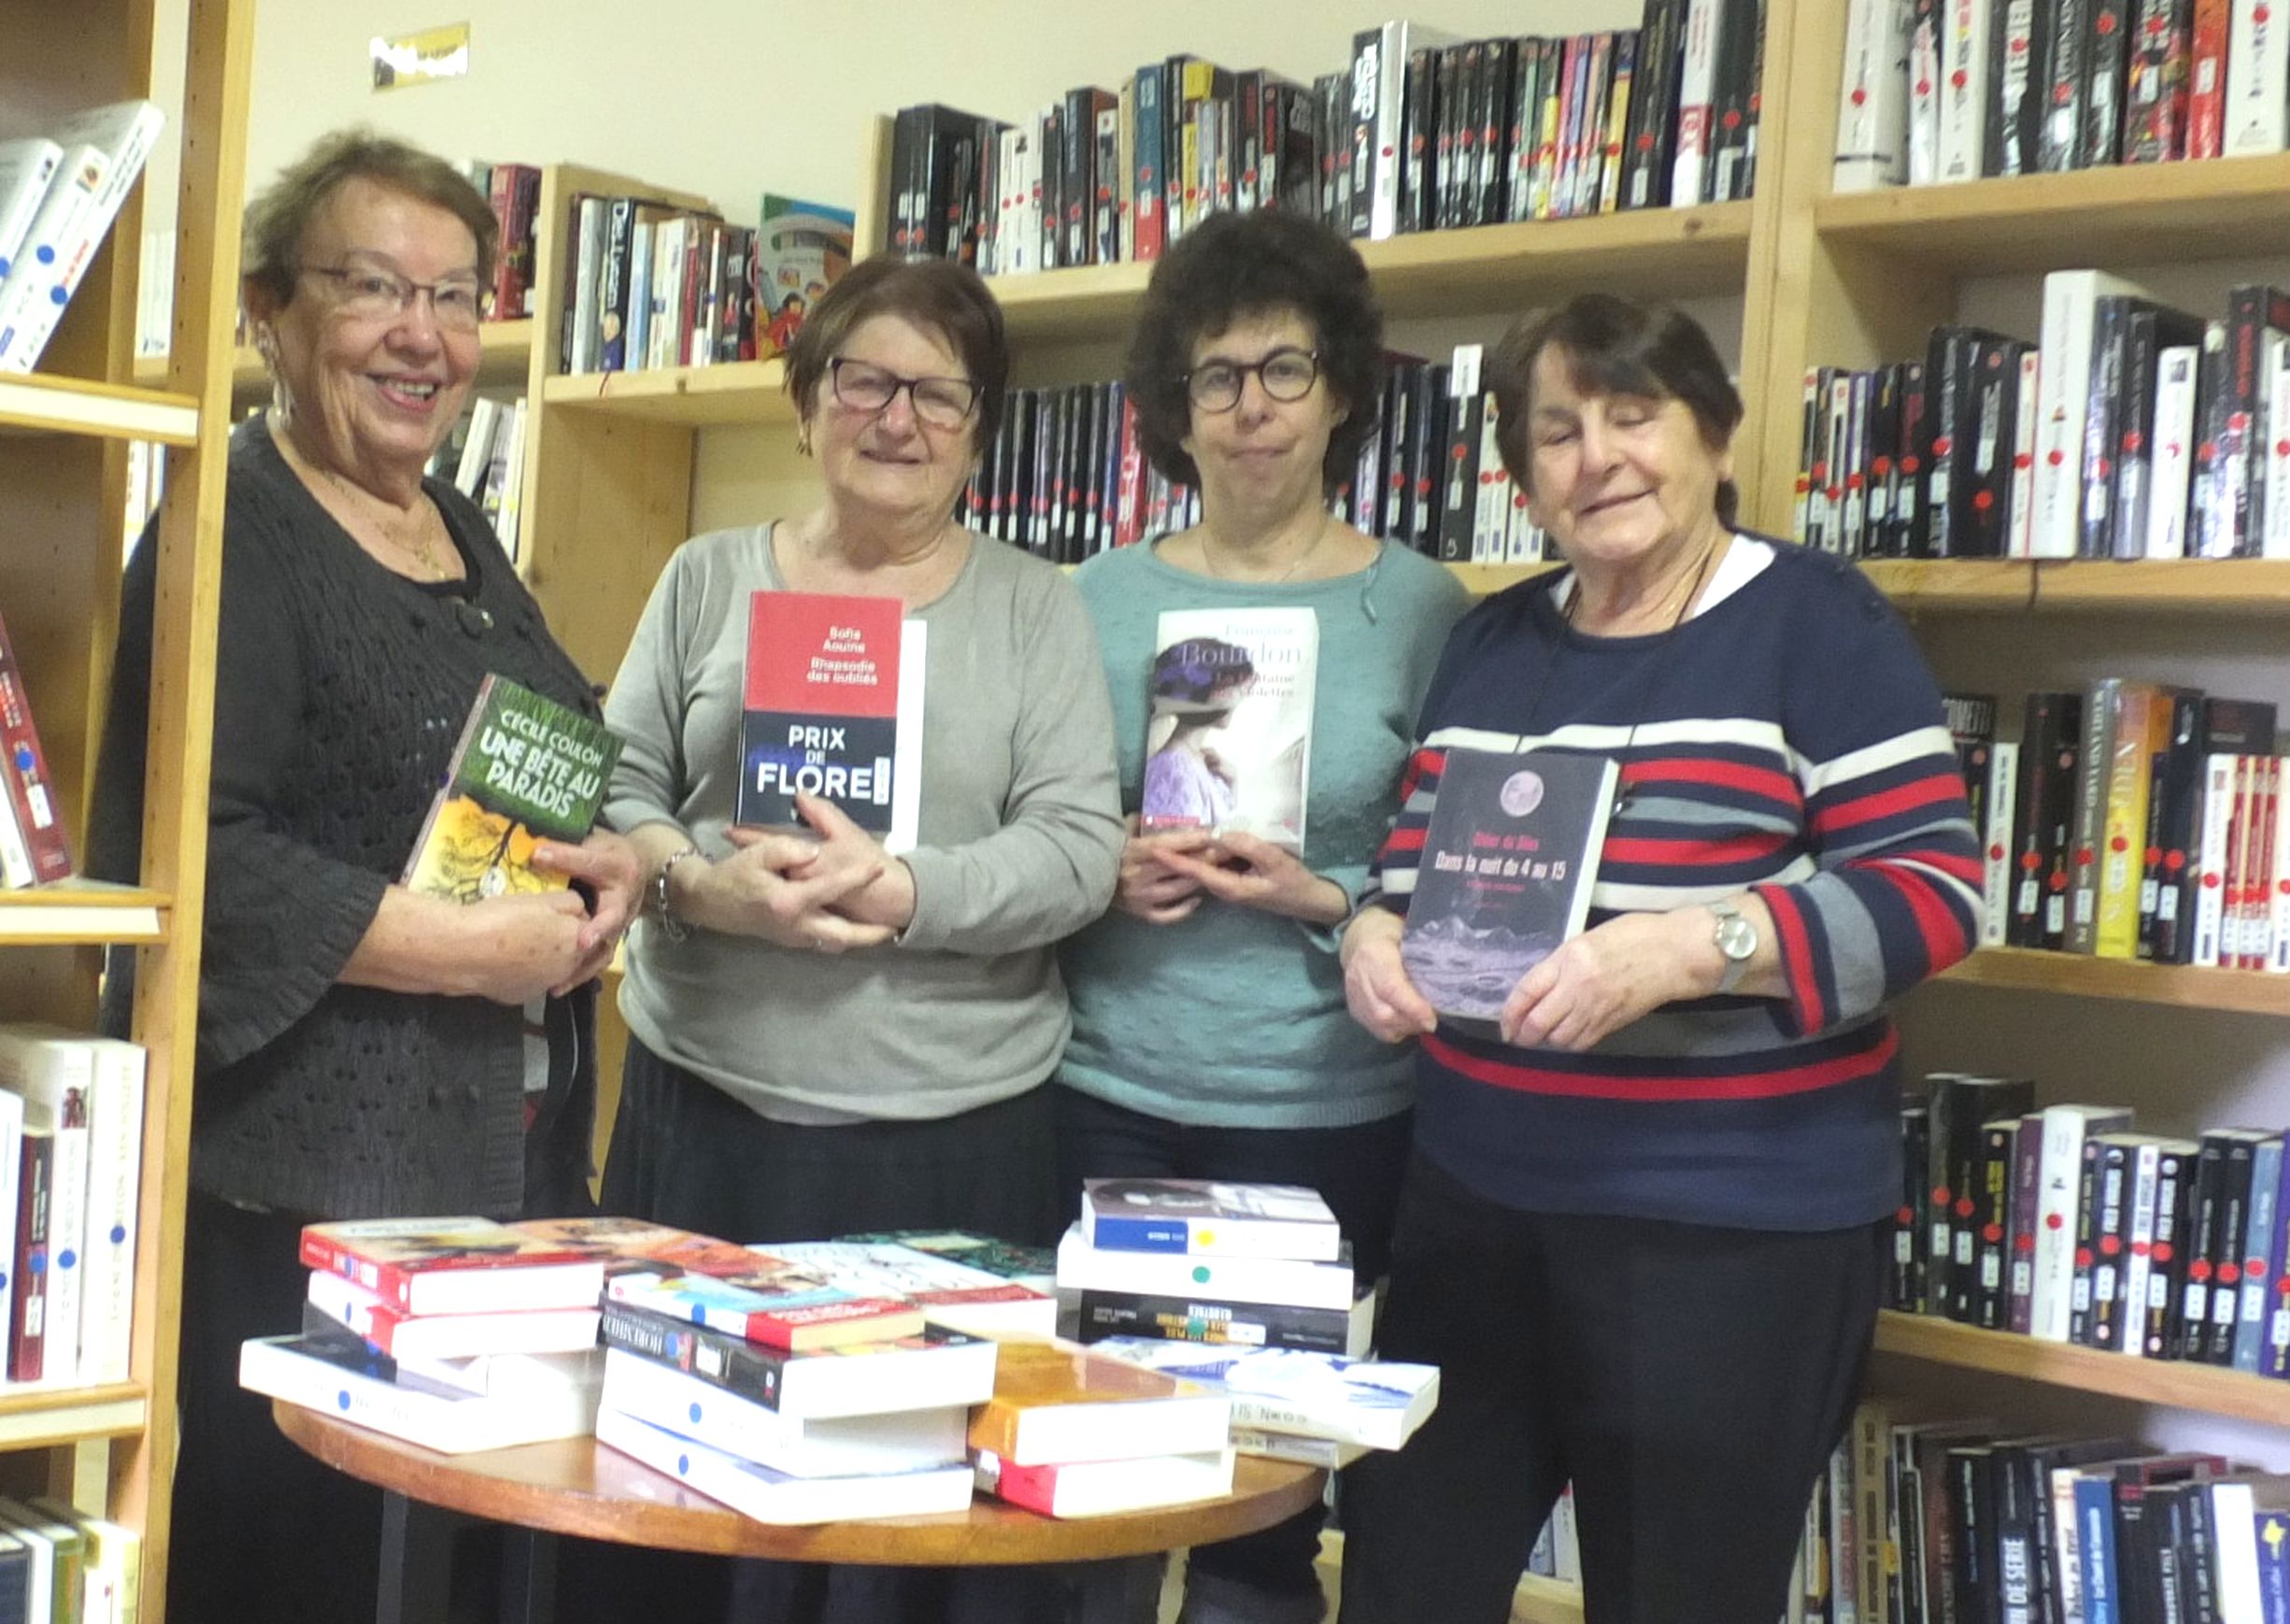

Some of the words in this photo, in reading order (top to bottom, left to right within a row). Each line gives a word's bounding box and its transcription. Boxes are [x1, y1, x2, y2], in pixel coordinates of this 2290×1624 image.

[1181, 641, 1301, 665] Bourdon
[549, 732, 604, 768] COULON
[788, 724, 846, 750] PRIX
[479, 724, 527, 766] UNE
[566, 769, 602, 800] AU
[805, 749, 826, 765] DE
[485, 759, 576, 819] PARADIS
[757, 762, 873, 800] FLORE
[1435, 849, 1464, 872] Dans
[1464, 853, 1477, 873] la
[1478, 856, 1502, 876] nuit
[1502, 857, 1519, 876] du
[1520, 858, 1531, 876] 4
[1530, 862, 1548, 879] au
[1551, 861, 1566, 880] 15
